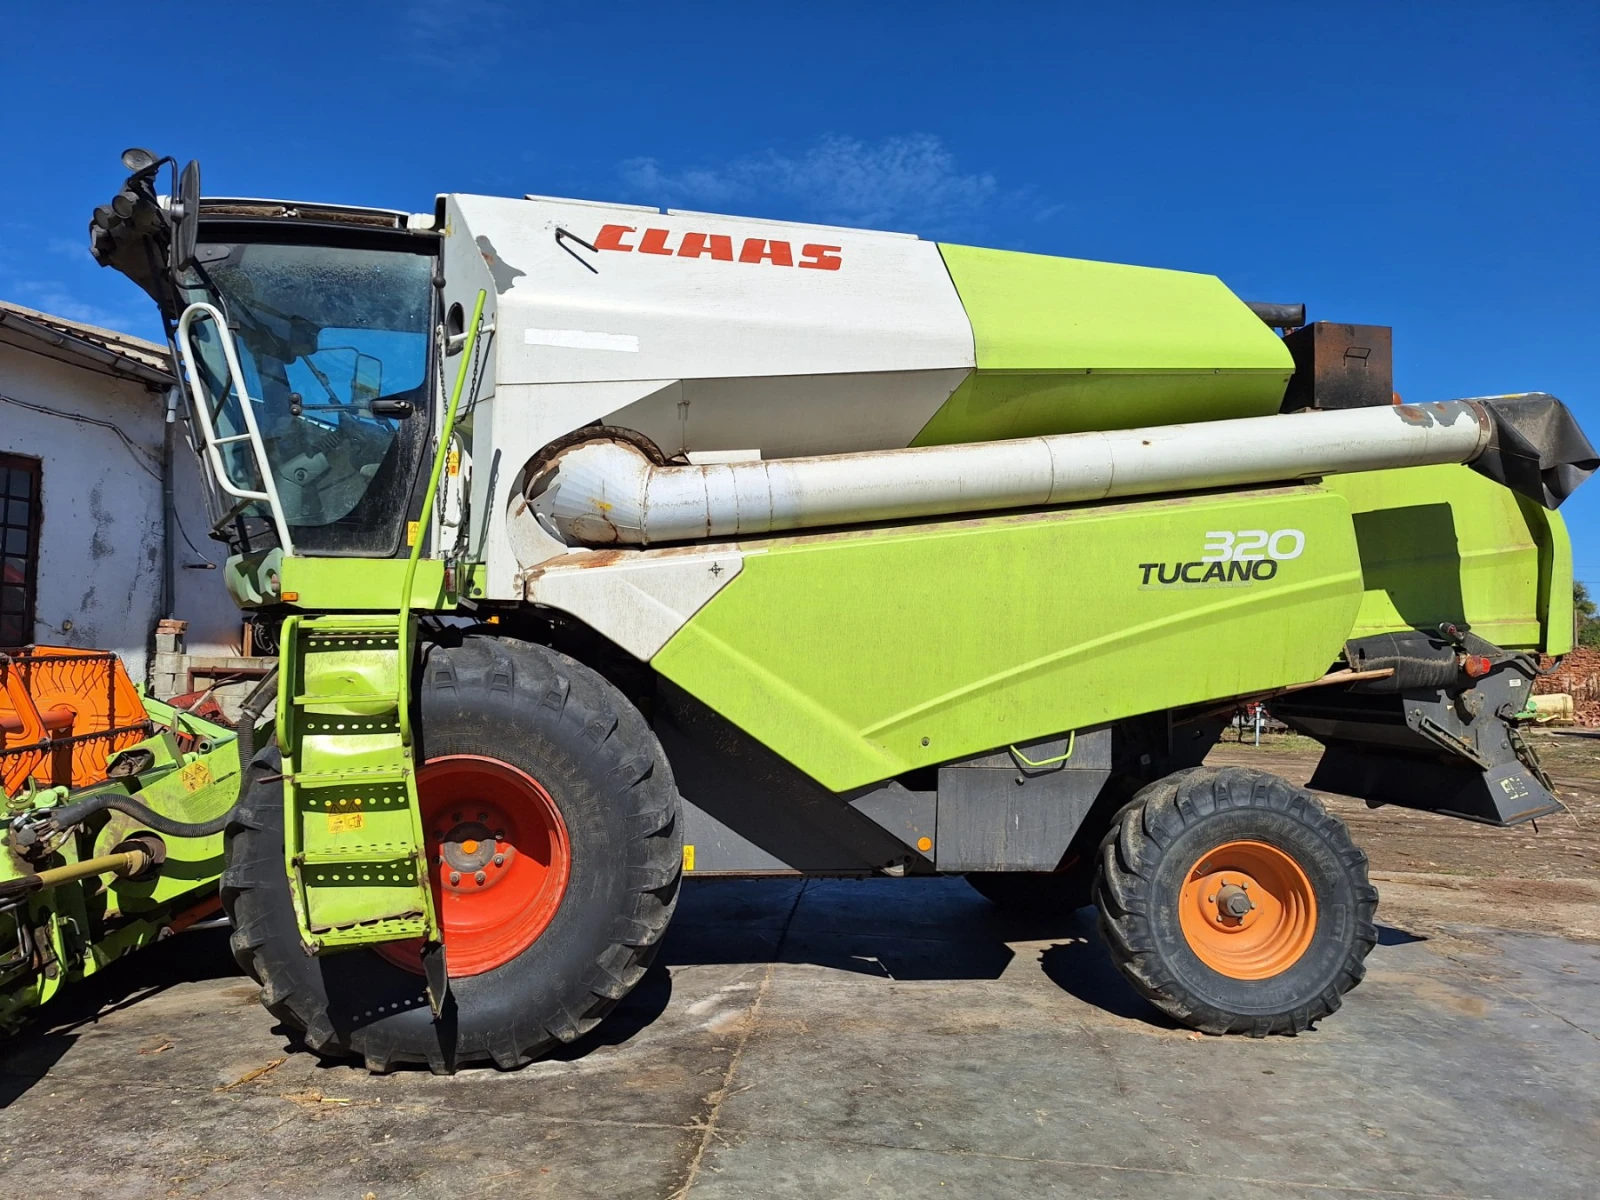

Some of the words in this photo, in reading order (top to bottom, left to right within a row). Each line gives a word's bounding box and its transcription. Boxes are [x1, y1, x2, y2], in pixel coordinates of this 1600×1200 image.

[594, 224, 842, 271] CLAAS
[1201, 529, 1305, 563] 320
[1138, 559, 1278, 585] TUCANO
